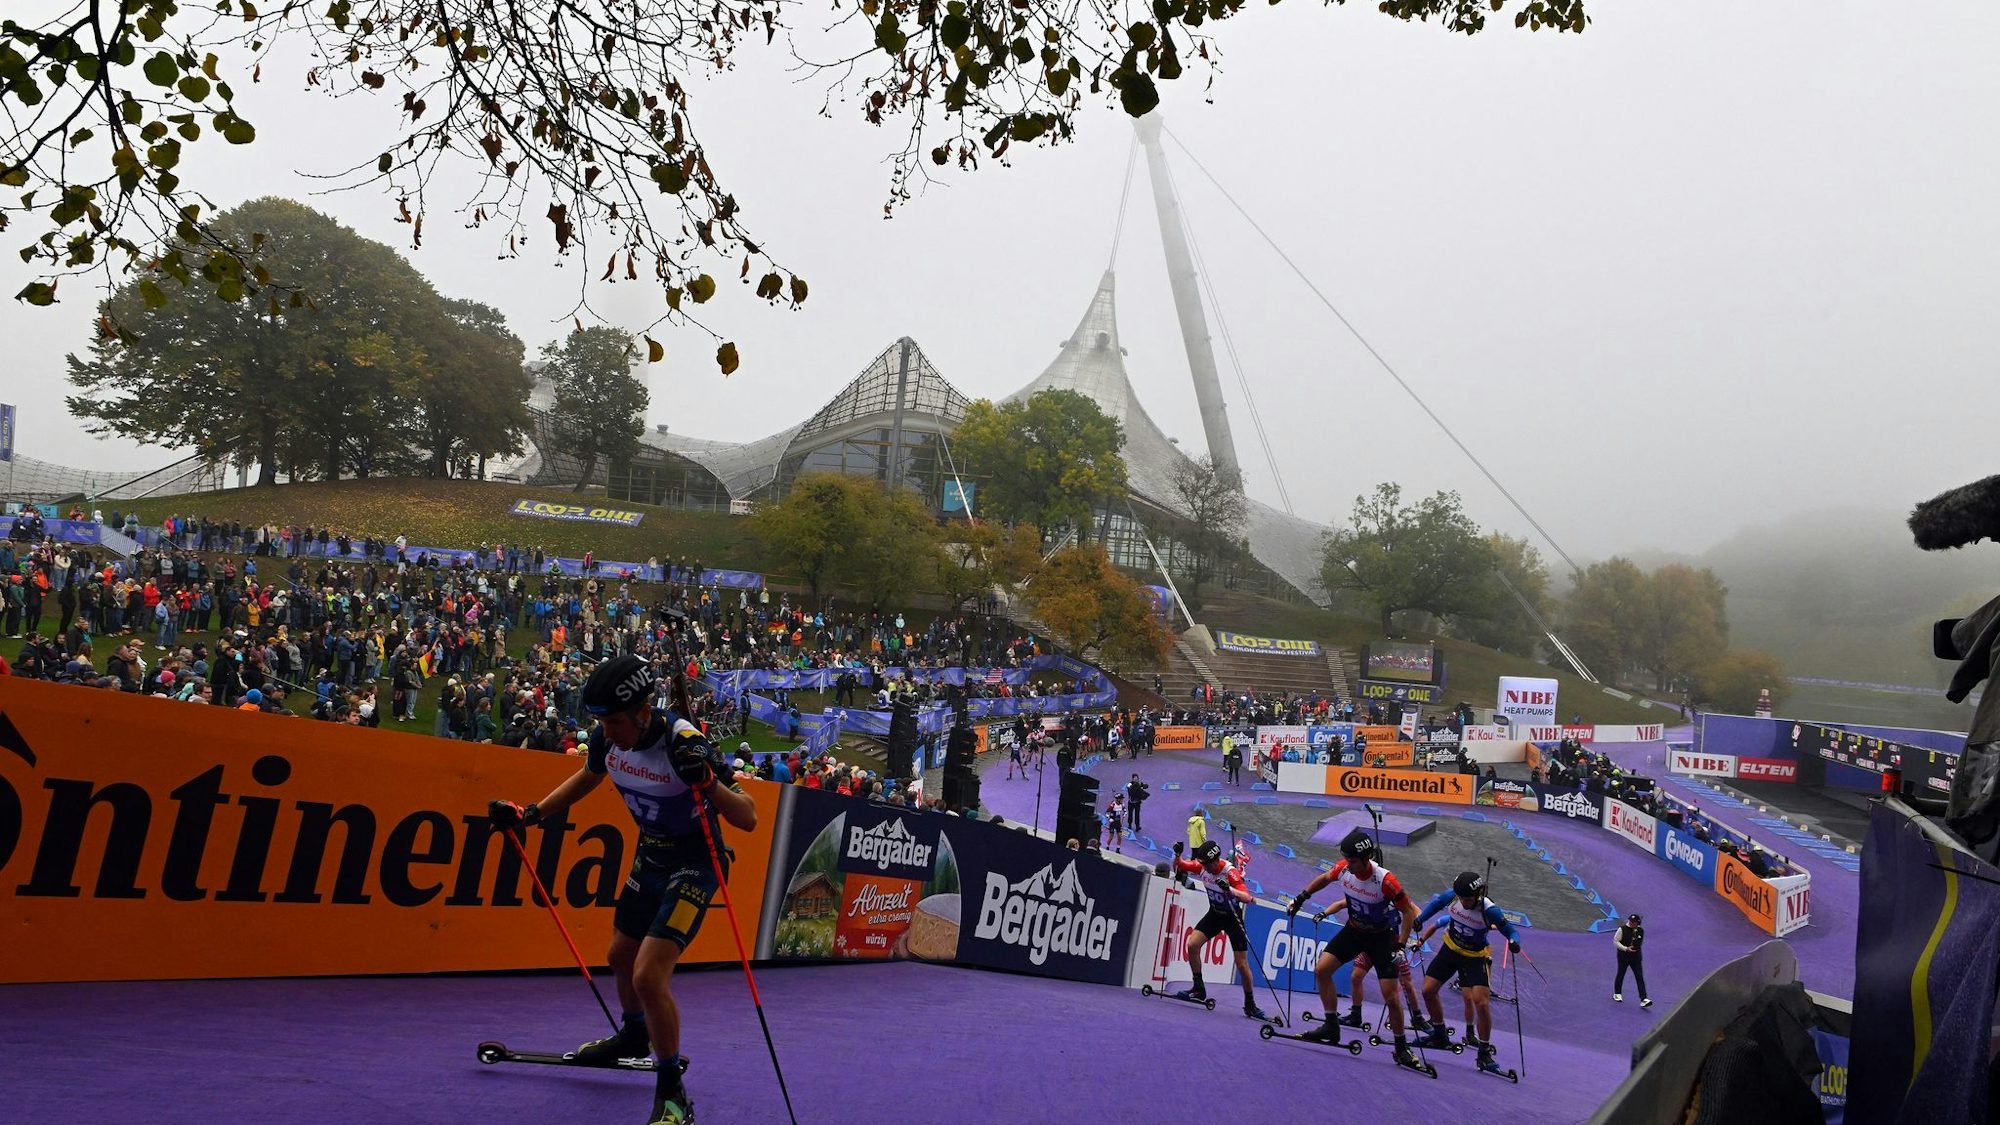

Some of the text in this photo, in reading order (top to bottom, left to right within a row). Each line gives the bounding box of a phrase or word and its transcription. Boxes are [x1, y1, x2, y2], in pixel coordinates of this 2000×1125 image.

[517, 501, 639, 521] LOOP ONE
[1221, 632, 1314, 650] LOOP ONE
[1222, 645, 1255, 653] BIATHLON
[615, 664, 655, 702] SWE
[1363, 684, 1431, 702] LOOP ONE
[1505, 690, 1554, 705] NIBE
[1503, 707, 1553, 716] HEAT PUMPS
[1270, 733, 1305, 744] Kaufland
[1529, 727, 1561, 740] NIBE
[1562, 729, 1592, 739] ELTEN
[1636, 725, 1661, 740] NIBE
[619, 760, 671, 783] Kaufland
[1677, 756, 1730, 772] NIBE
[1739, 763, 1796, 777] ELTEN
[1340, 770, 1446, 795] Continental
[1494, 781, 1525, 791] Bergader
[1543, 793, 1600, 820] Bergader
[1622, 810, 1653, 844] Kaufland
[847, 825, 933, 870] Bergader
[1207, 845, 1221, 860] SUI
[1355, 839, 1373, 853] SUI
[1665, 830, 1704, 870] CONRAD
[848, 883, 913, 918] Almzeit
[868, 913, 888, 925] extra
[973, 871, 1119, 966] Bergader
[865, 933, 888, 948] würzig
